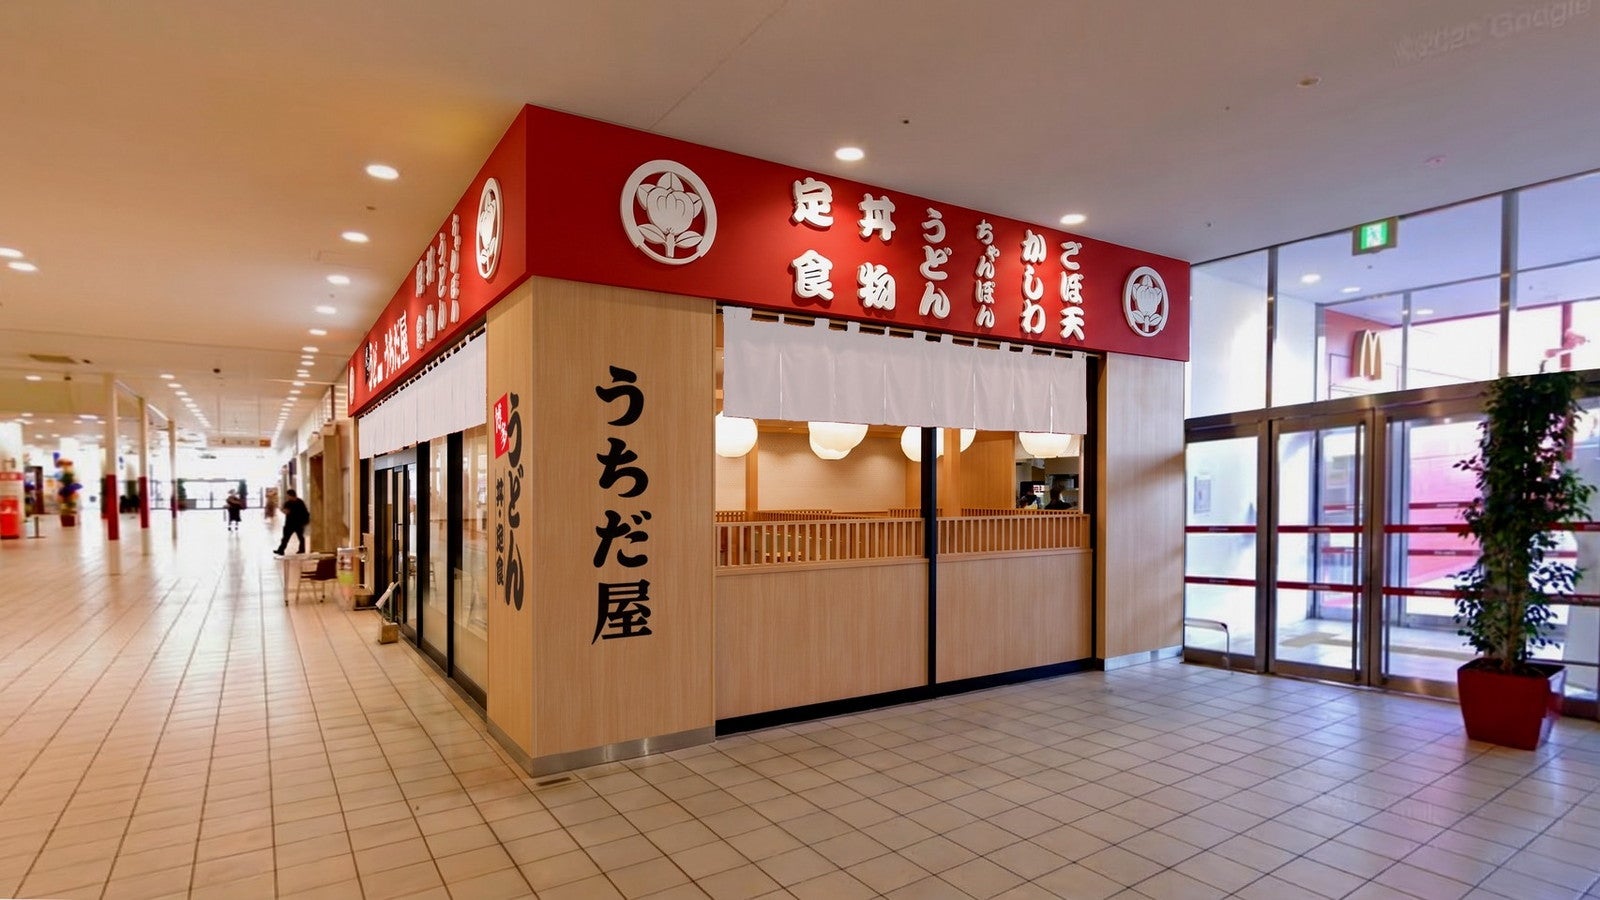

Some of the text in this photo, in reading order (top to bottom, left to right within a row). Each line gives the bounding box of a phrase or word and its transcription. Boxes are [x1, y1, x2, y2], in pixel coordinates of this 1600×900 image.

[792, 177, 834, 301] 定食
[857, 193, 897, 312] 丼物
[919, 207, 952, 320] うどん
[975, 219, 1001, 329] ちゃんぽん
[1020, 229, 1047, 335] かしわ
[1059, 241, 1085, 341] ごぼ天
[505, 392, 524, 611] うどん
[591, 365, 652, 646] うちだ屋
